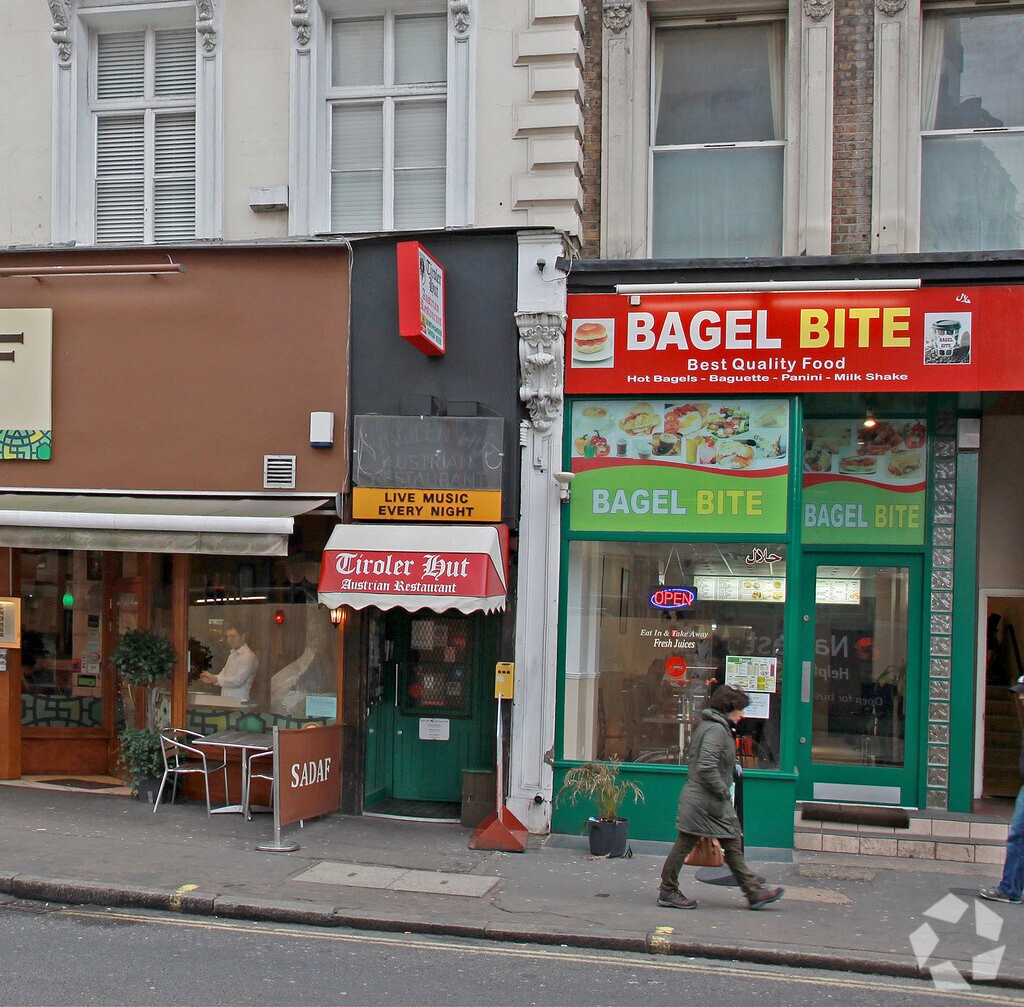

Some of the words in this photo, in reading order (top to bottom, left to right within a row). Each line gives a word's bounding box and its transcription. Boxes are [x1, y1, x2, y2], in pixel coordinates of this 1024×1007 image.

[627, 309, 781, 351] BAGEL
[799, 307, 911, 349] BITE
[687, 358, 728, 371] Best
[732, 357, 797, 373] Quality
[802, 357, 846, 370] Food
[627, 375, 651, 383] Hot
[653, 374, 698, 384] Bagels
[709, 374, 770, 384] Baguette
[781, 373, 823, 382] Panini
[834, 373, 862, 381] Milk
[865, 372, 908, 381] Shake
[384, 492, 416, 503] LIVE
[423, 493, 469, 504] MUSIC
[592, 488, 686, 515] BAGEL
[696, 489, 764, 516] BITE
[378, 505, 423, 516] EVERY
[431, 506, 474, 517] NIGHT
[804, 503, 868, 528] BAGEL
[874, 504, 920, 529] BITE
[334, 552, 415, 576] Tiroler
[421, 554, 470, 581] Hut
[340, 578, 390, 591] Austrian
[393, 580, 457, 593] Restaurant
[654, 590, 693, 606] OPEN
[640, 628, 653, 637] Eat
[654, 629, 662, 637] In
[663, 629, 670, 637] &
[671, 629, 689, 638] Take
[689, 630, 709, 640] Away
[653, 638, 673, 648] Fresh
[673, 639, 696, 649] Juices
[291, 757, 331, 788] SADAF
